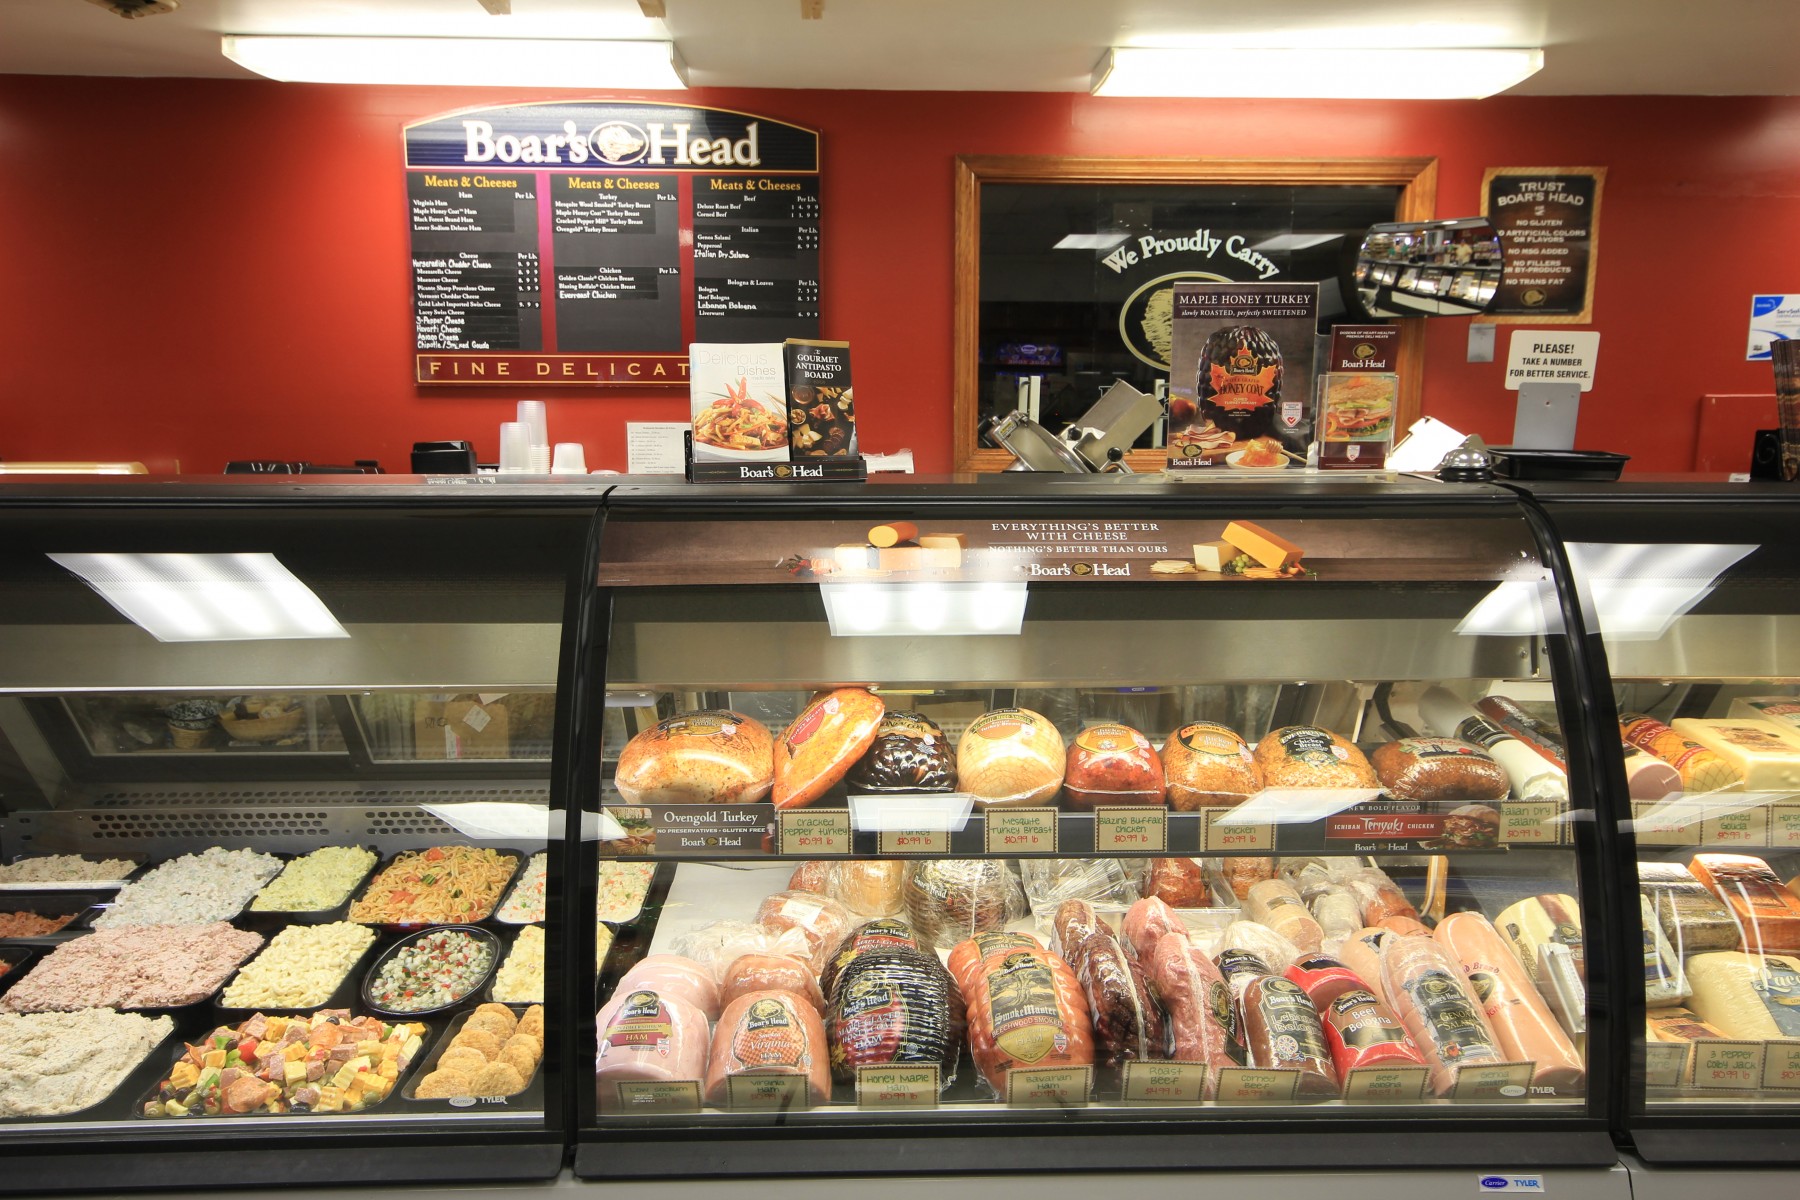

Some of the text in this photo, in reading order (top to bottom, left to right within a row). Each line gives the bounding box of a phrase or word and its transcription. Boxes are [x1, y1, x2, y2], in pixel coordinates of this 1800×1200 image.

[463, 120, 760, 166] Boar's Head
[424, 175, 517, 188] Meats & Cheeses
[568, 177, 660, 190] Meats & Cheeses
[711, 179, 801, 190] Meats & Cheeses
[1519, 182, 1565, 192] TRUST
[1498, 192, 1584, 206] BOAR'S HEAD
[1102, 228, 1280, 280] We Proudly Carry
[1180, 295, 1311, 304] MAPLE HONEY TURKEY
[698, 301, 757, 310] Lebanon Bologna
[1533, 343, 1574, 354] PLEASE!
[700, 351, 768, 365] Delicious
[797, 354, 839, 364] GOURMET
[1522, 357, 1582, 367] TAKE A NUMBER
[430, 362, 510, 375] FINE
[796, 362, 842, 372] ANTIPASTO
[1342, 360, 1385, 368] Boar's Head
[737, 366, 776, 376] Dishes
[804, 371, 834, 380] BOARD
[1509, 369, 1591, 378] FOR BETTER SERVICE.
[1220, 383, 1264, 396] HONEY COAT
[740, 465, 823, 478] Boar's Head
[1026, 532, 1128, 541] WITH CHEESE
[1030, 563, 1130, 576] Boar's Head
[664, 811, 758, 826] Ovengold Turkey
[1360, 818, 1404, 834] Teriyaki
[681, 837, 741, 846] Boar's Head
[798, 837, 833, 846] $10.99 lb
[897, 837, 931, 846] $10.99 lb
[1004, 835, 1039, 844] $10.99 lb
[1114, 835, 1137, 843] $10.99
[889, 929, 910, 938] Head
[1428, 996, 1446, 1006] Boar's
[994, 1004, 1057, 1025] SmokeMaster
[1352, 1007, 1376, 1019] Beef
[992, 1018, 1033, 1037] BEECHWOOD
[1034, 1016, 1063, 1027] SMOKED
[1348, 1018, 1391, 1033] Bologna
[751, 1040, 791, 1050] Virginia
[1530, 1086, 1556, 1095] TYLER
[480, 1096, 508, 1104] TYLER
[1514, 1179, 1540, 1188] TYLER
